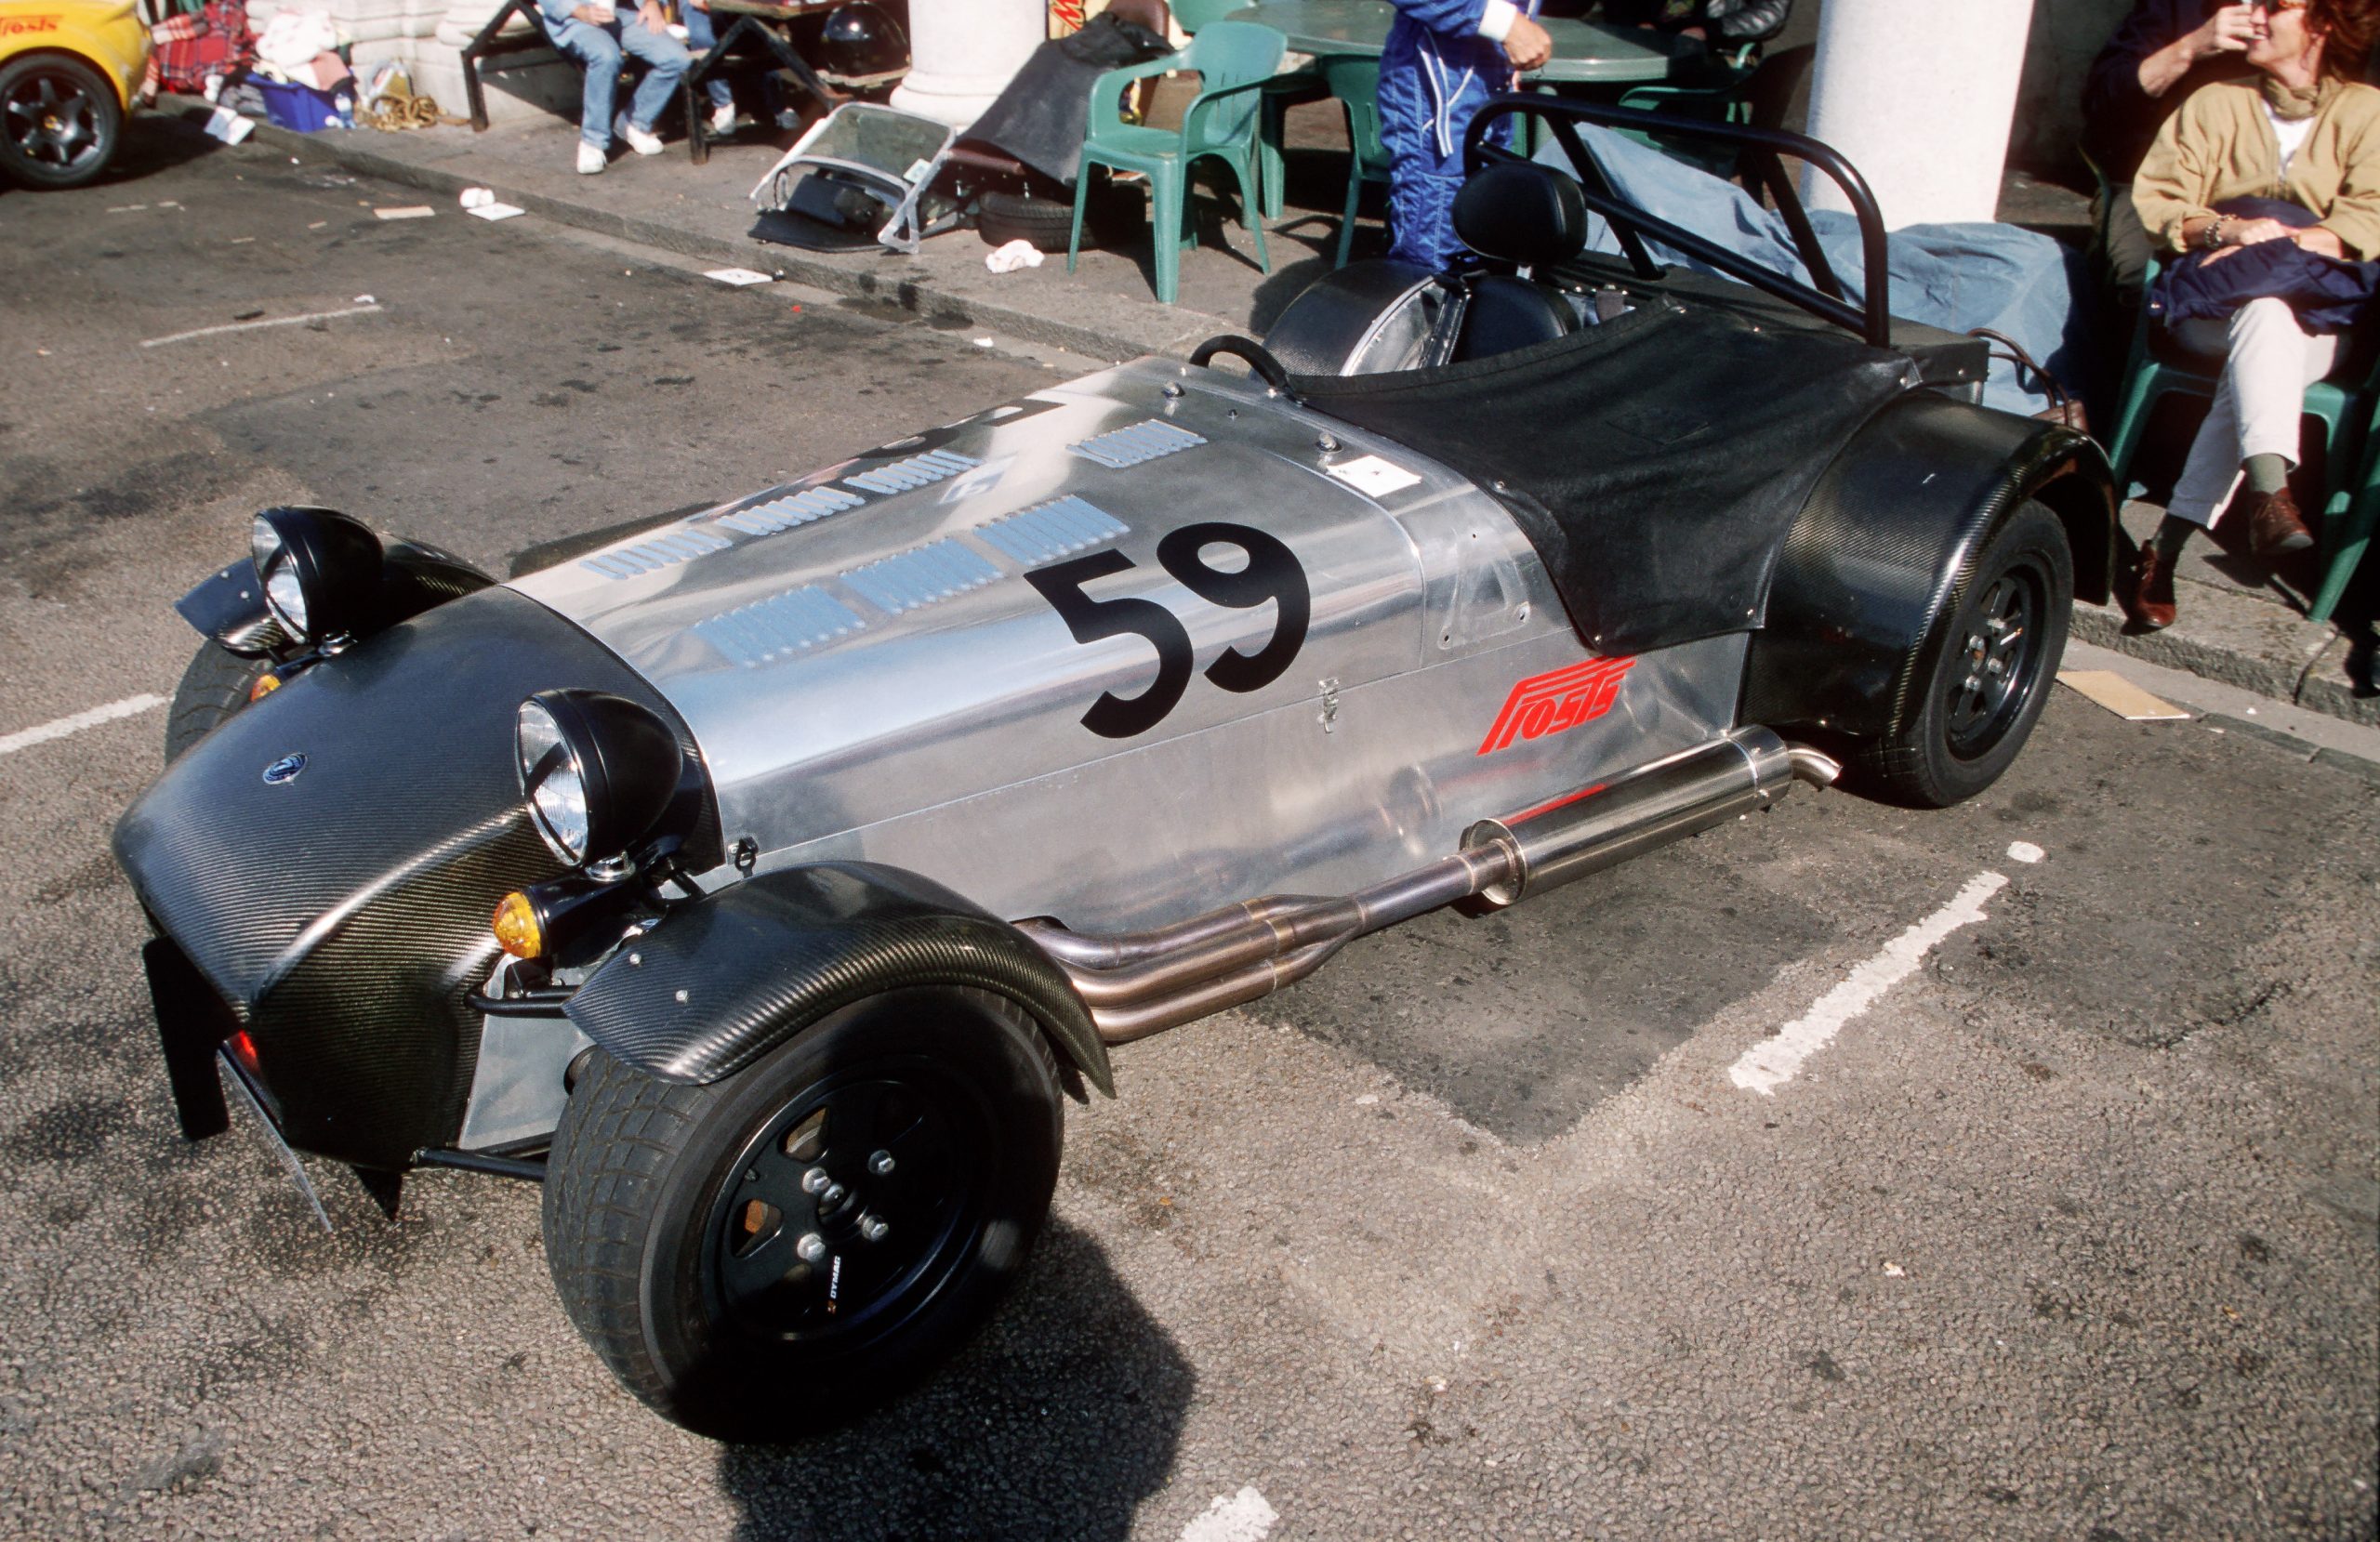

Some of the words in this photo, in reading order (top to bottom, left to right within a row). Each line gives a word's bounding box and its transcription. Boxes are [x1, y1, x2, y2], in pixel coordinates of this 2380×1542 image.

[1023, 521, 1311, 739] 59
[1476, 654, 1636, 756] Frosts
[830, 1255, 841, 1299] DYMAG
